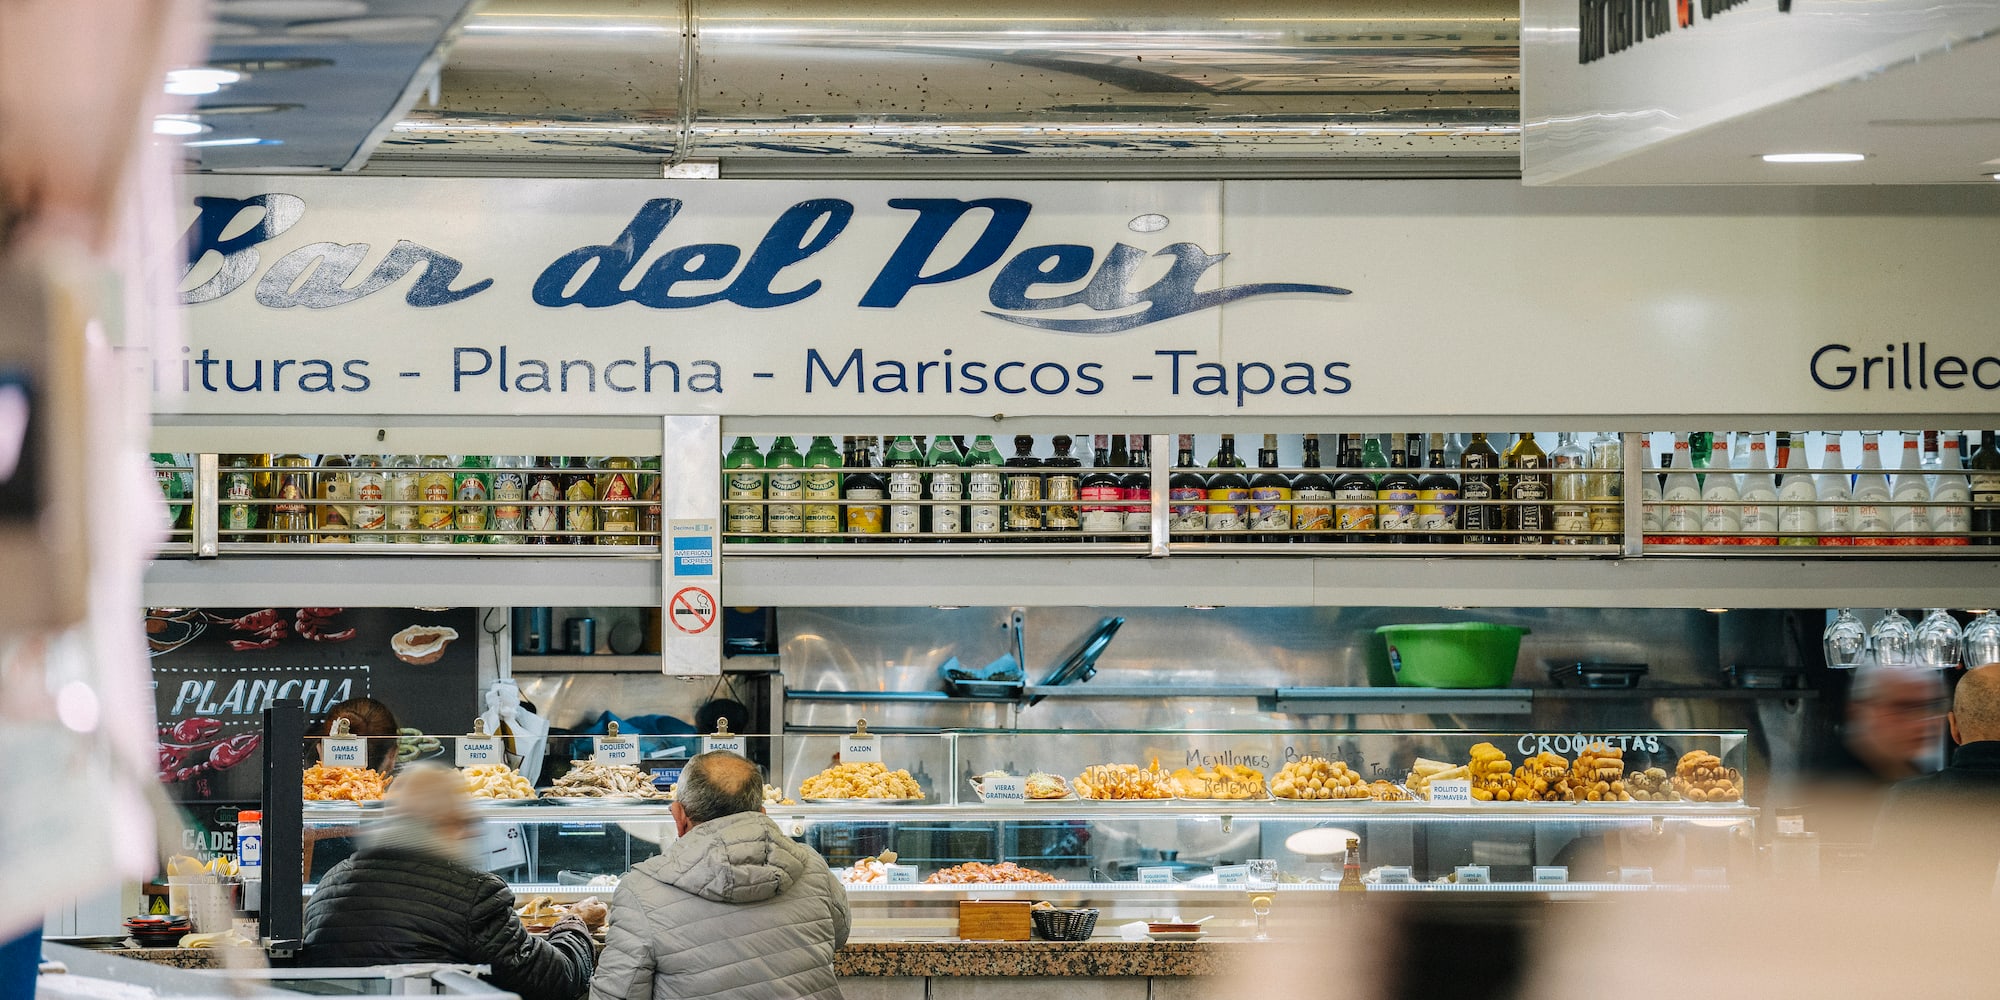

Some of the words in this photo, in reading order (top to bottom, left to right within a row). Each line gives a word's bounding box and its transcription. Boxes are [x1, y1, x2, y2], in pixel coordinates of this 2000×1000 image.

[177, 193, 493, 308] Bar
[532, 198, 854, 308] del
[453, 346, 723, 393] Plancha
[805, 348, 1105, 394] Mariscos
[892, 484, 919, 493] MARTINI
[933, 484, 961, 493] MARTINI
[972, 484, 999, 493] MARTINI
[171, 679, 352, 715] PLANCHA
[600, 742, 634, 750] BOQUERON
[1517, 732, 1660, 757] CROQUETAS
[334, 753, 355, 761] FRITAS
[985, 792, 1024, 800] GRATINADAS
